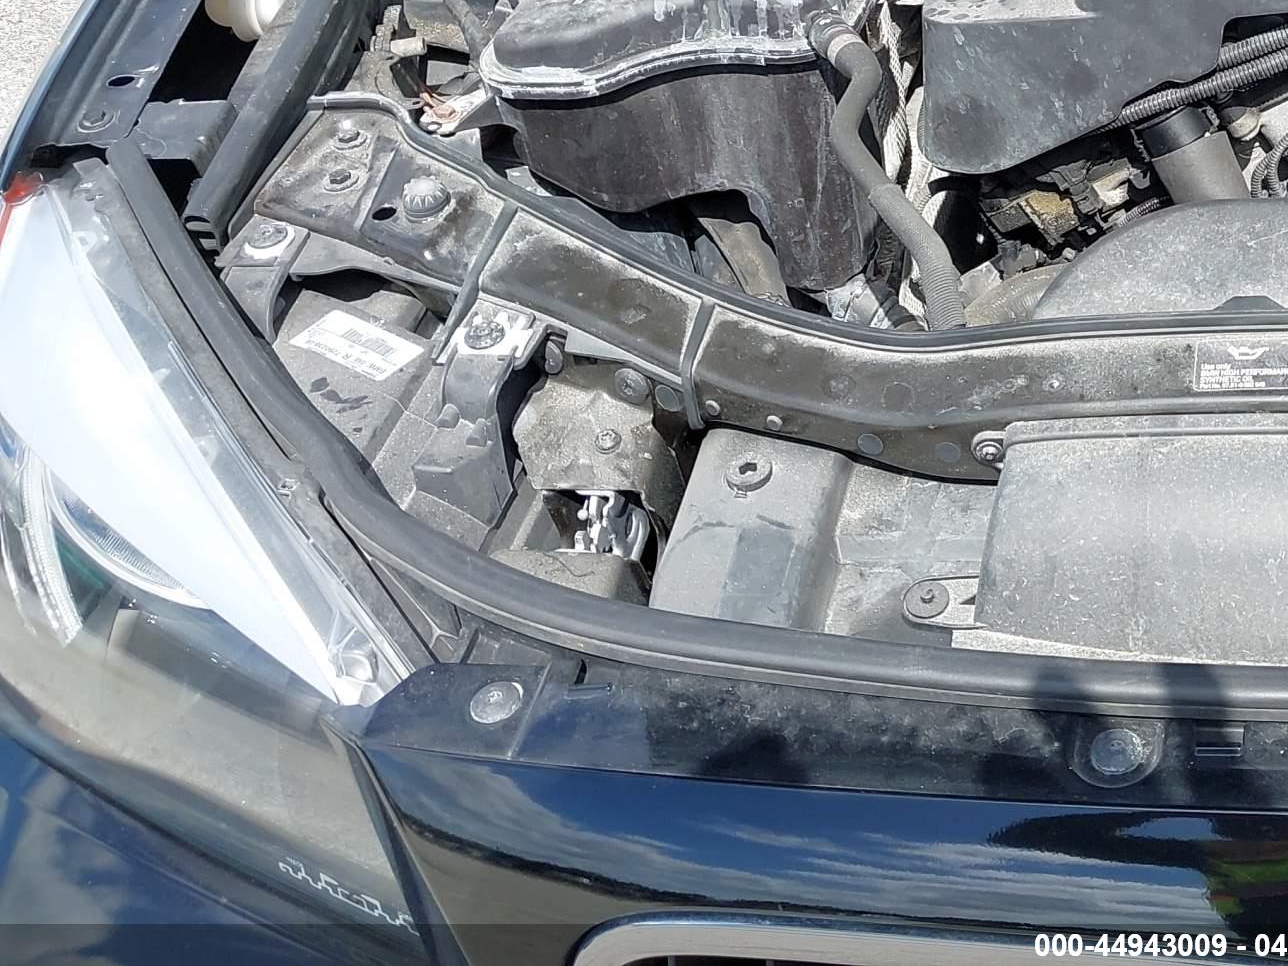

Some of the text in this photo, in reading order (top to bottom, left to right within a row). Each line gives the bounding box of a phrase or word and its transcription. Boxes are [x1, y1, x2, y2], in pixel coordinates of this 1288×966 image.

[1216, 362, 1232, 370] only
[1200, 369, 1219, 377] BMW
[1200, 375, 1241, 383] SYNTHETIC
